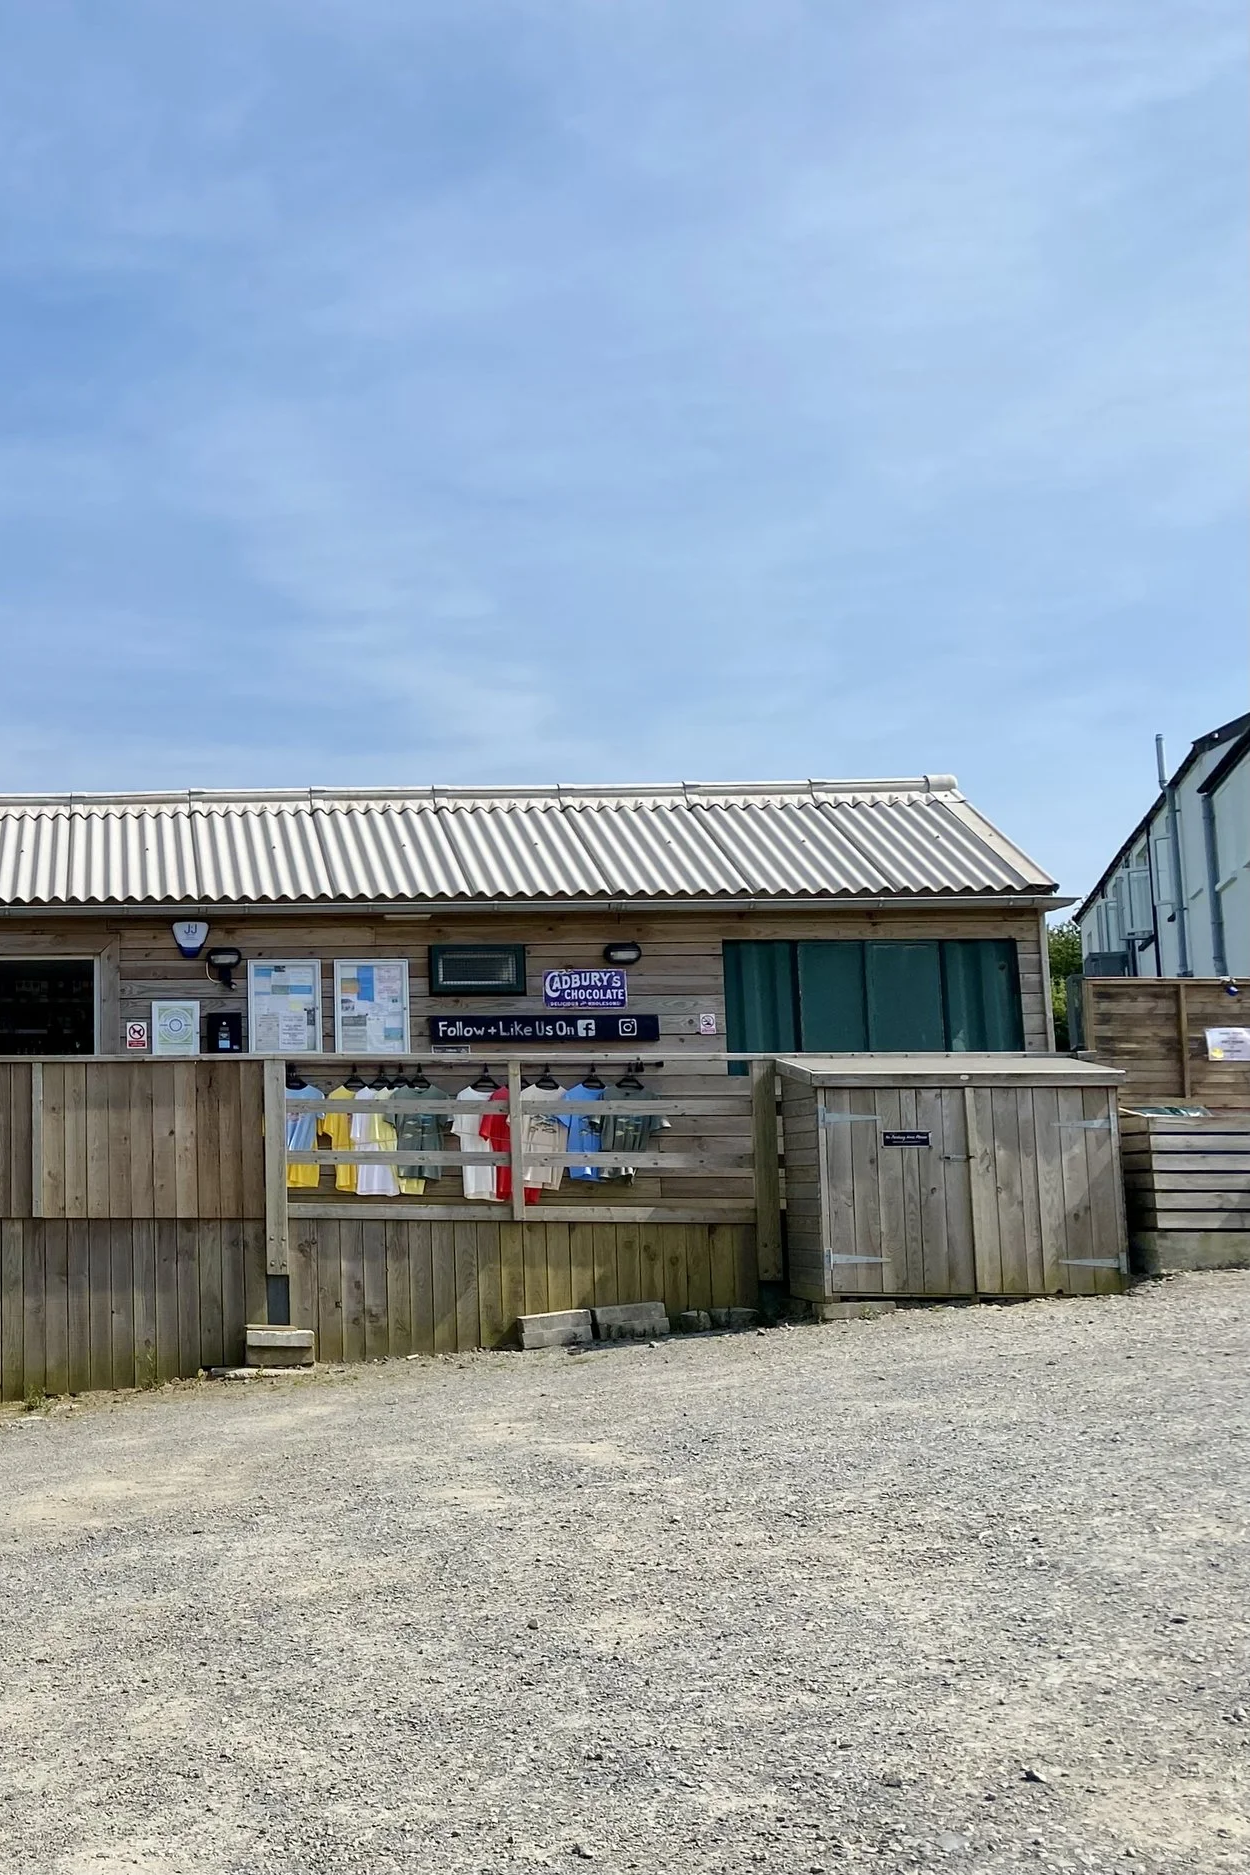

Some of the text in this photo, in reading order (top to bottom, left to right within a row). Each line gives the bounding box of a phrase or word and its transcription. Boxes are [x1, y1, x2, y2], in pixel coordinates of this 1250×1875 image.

[564, 989, 625, 1000] CHOCOLATE
[438, 1021, 485, 1037] Follow
[499, 1021, 533, 1036] Like
[535, 1021, 554, 1036] Us
[556, 1021, 575, 1036] On
